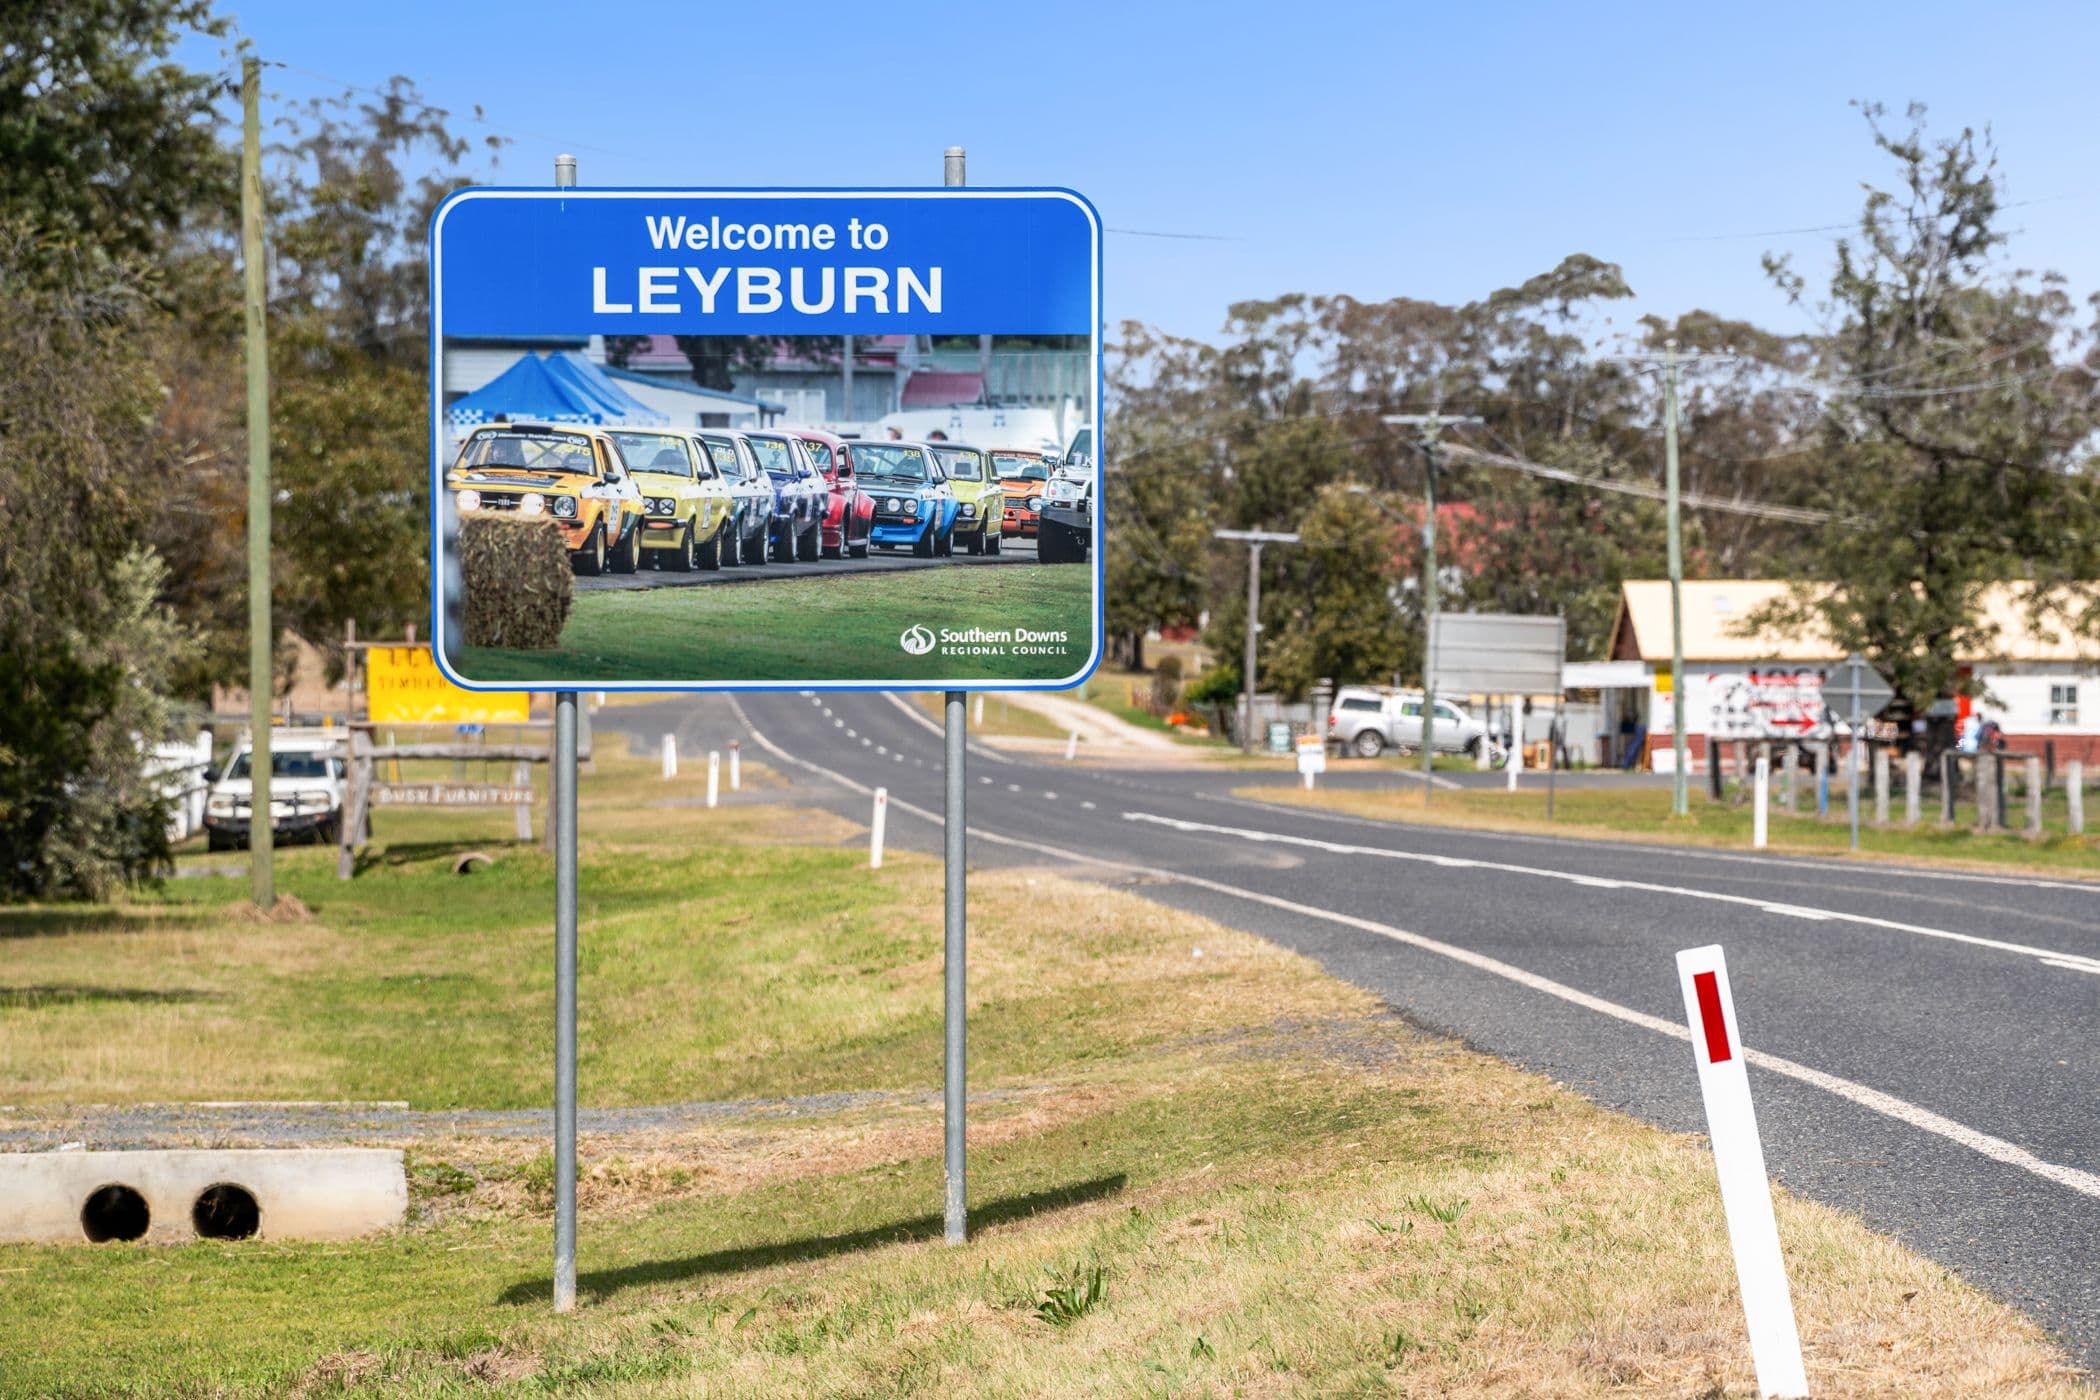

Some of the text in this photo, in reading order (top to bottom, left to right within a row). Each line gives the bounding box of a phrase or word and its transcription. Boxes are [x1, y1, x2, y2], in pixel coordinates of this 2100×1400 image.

[645, 215, 889, 251] Welcome to
[593, 266, 942, 315] LEYBURN
[940, 626, 1068, 643] Southern Downs
[941, 646, 1068, 655] REGIONAL COUNCIL
[432, 784, 535, 804] FURNITURE
